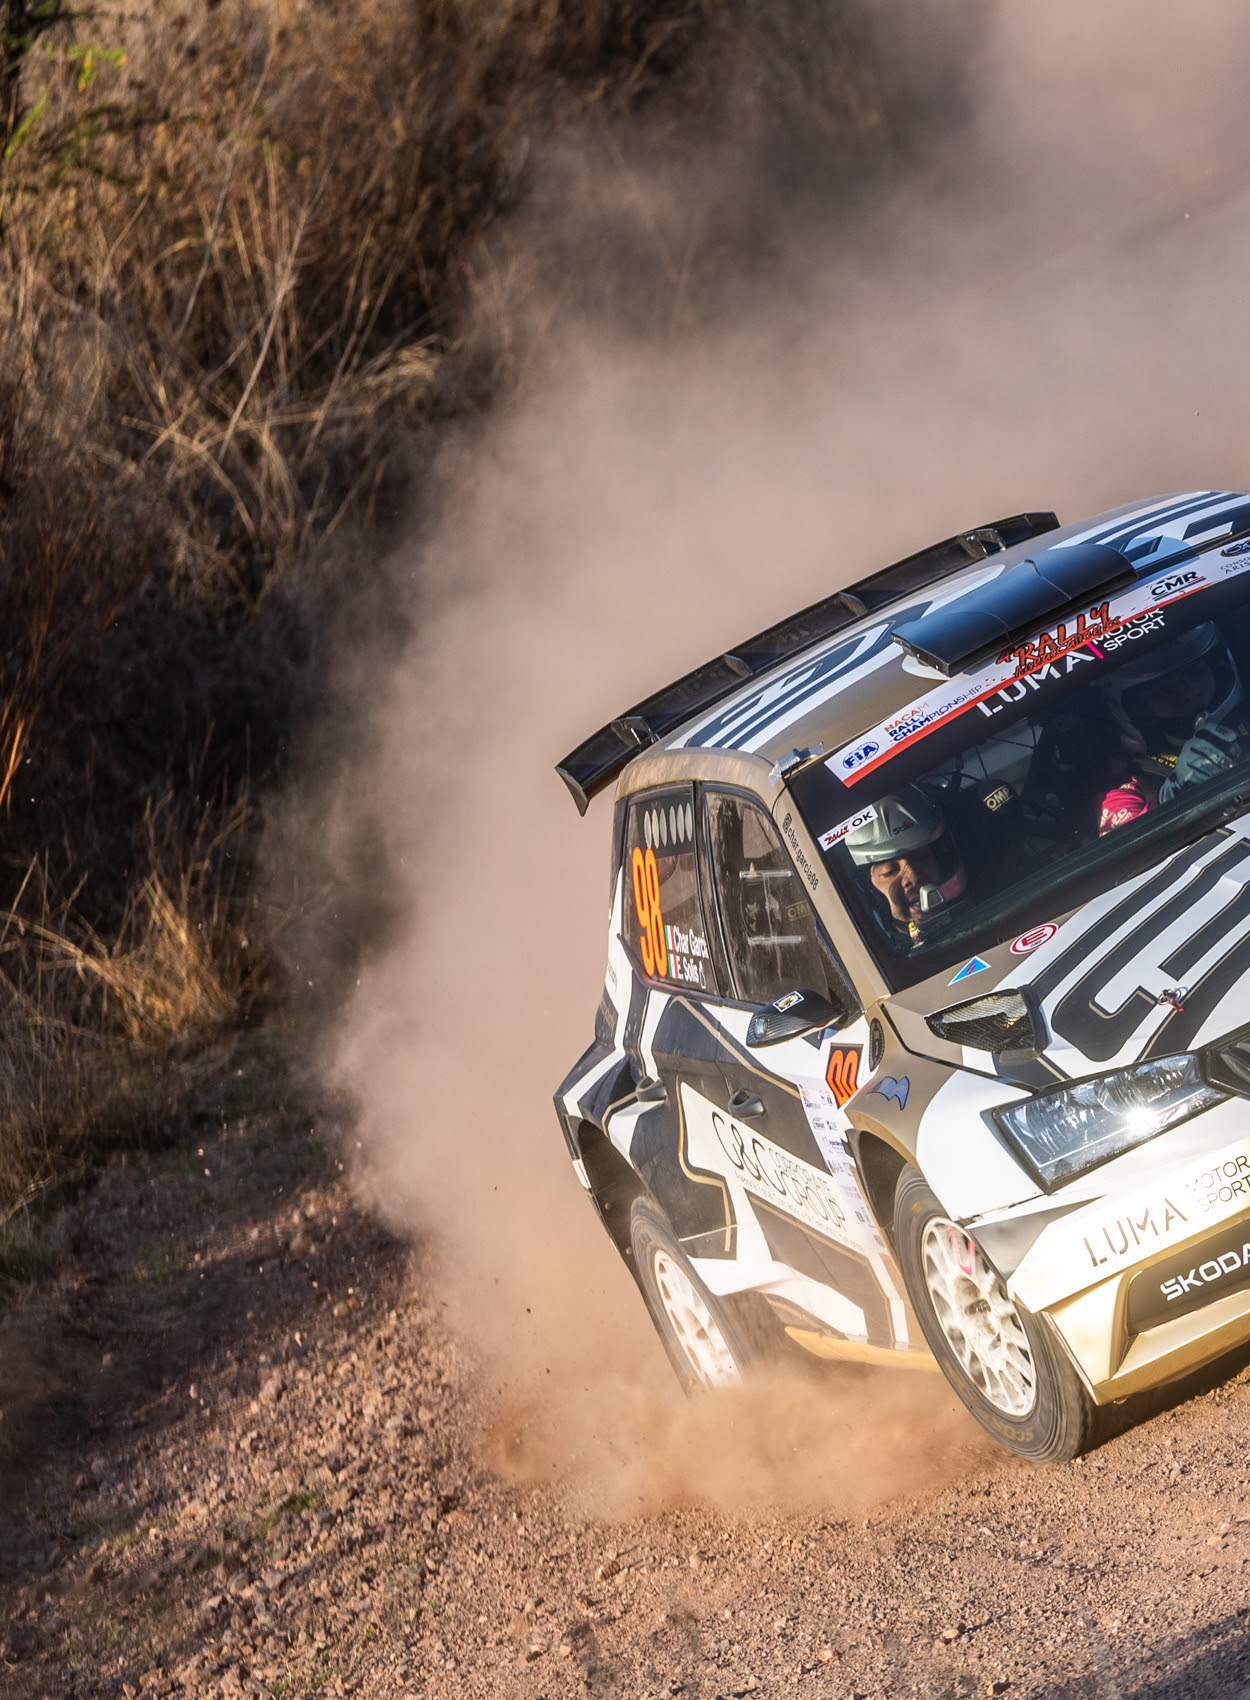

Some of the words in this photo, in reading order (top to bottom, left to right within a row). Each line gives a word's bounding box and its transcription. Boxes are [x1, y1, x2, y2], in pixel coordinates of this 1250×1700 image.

[1151, 571, 1198, 597] CMR
[1012, 602, 1111, 666] RALLY
[1092, 608, 1164, 645] MOTOR
[1103, 616, 1166, 652] SPORT
[976, 648, 1096, 718] LUMA
[884, 702, 930, 733] NACAM
[889, 711, 925, 738] RALLY
[893, 684, 982, 742] CHAMPIONSHIP
[986, 788, 1011, 809] OMP
[852, 811, 873, 827] OK
[782, 812, 819, 891] @char.garcia98
[632, 846, 667, 978] 98
[673, 925, 689, 954] Char
[768, 1148, 831, 1191] CORPORATE
[780, 1170, 847, 1233] GROUP
[1083, 1197, 1188, 1269] LUMA
